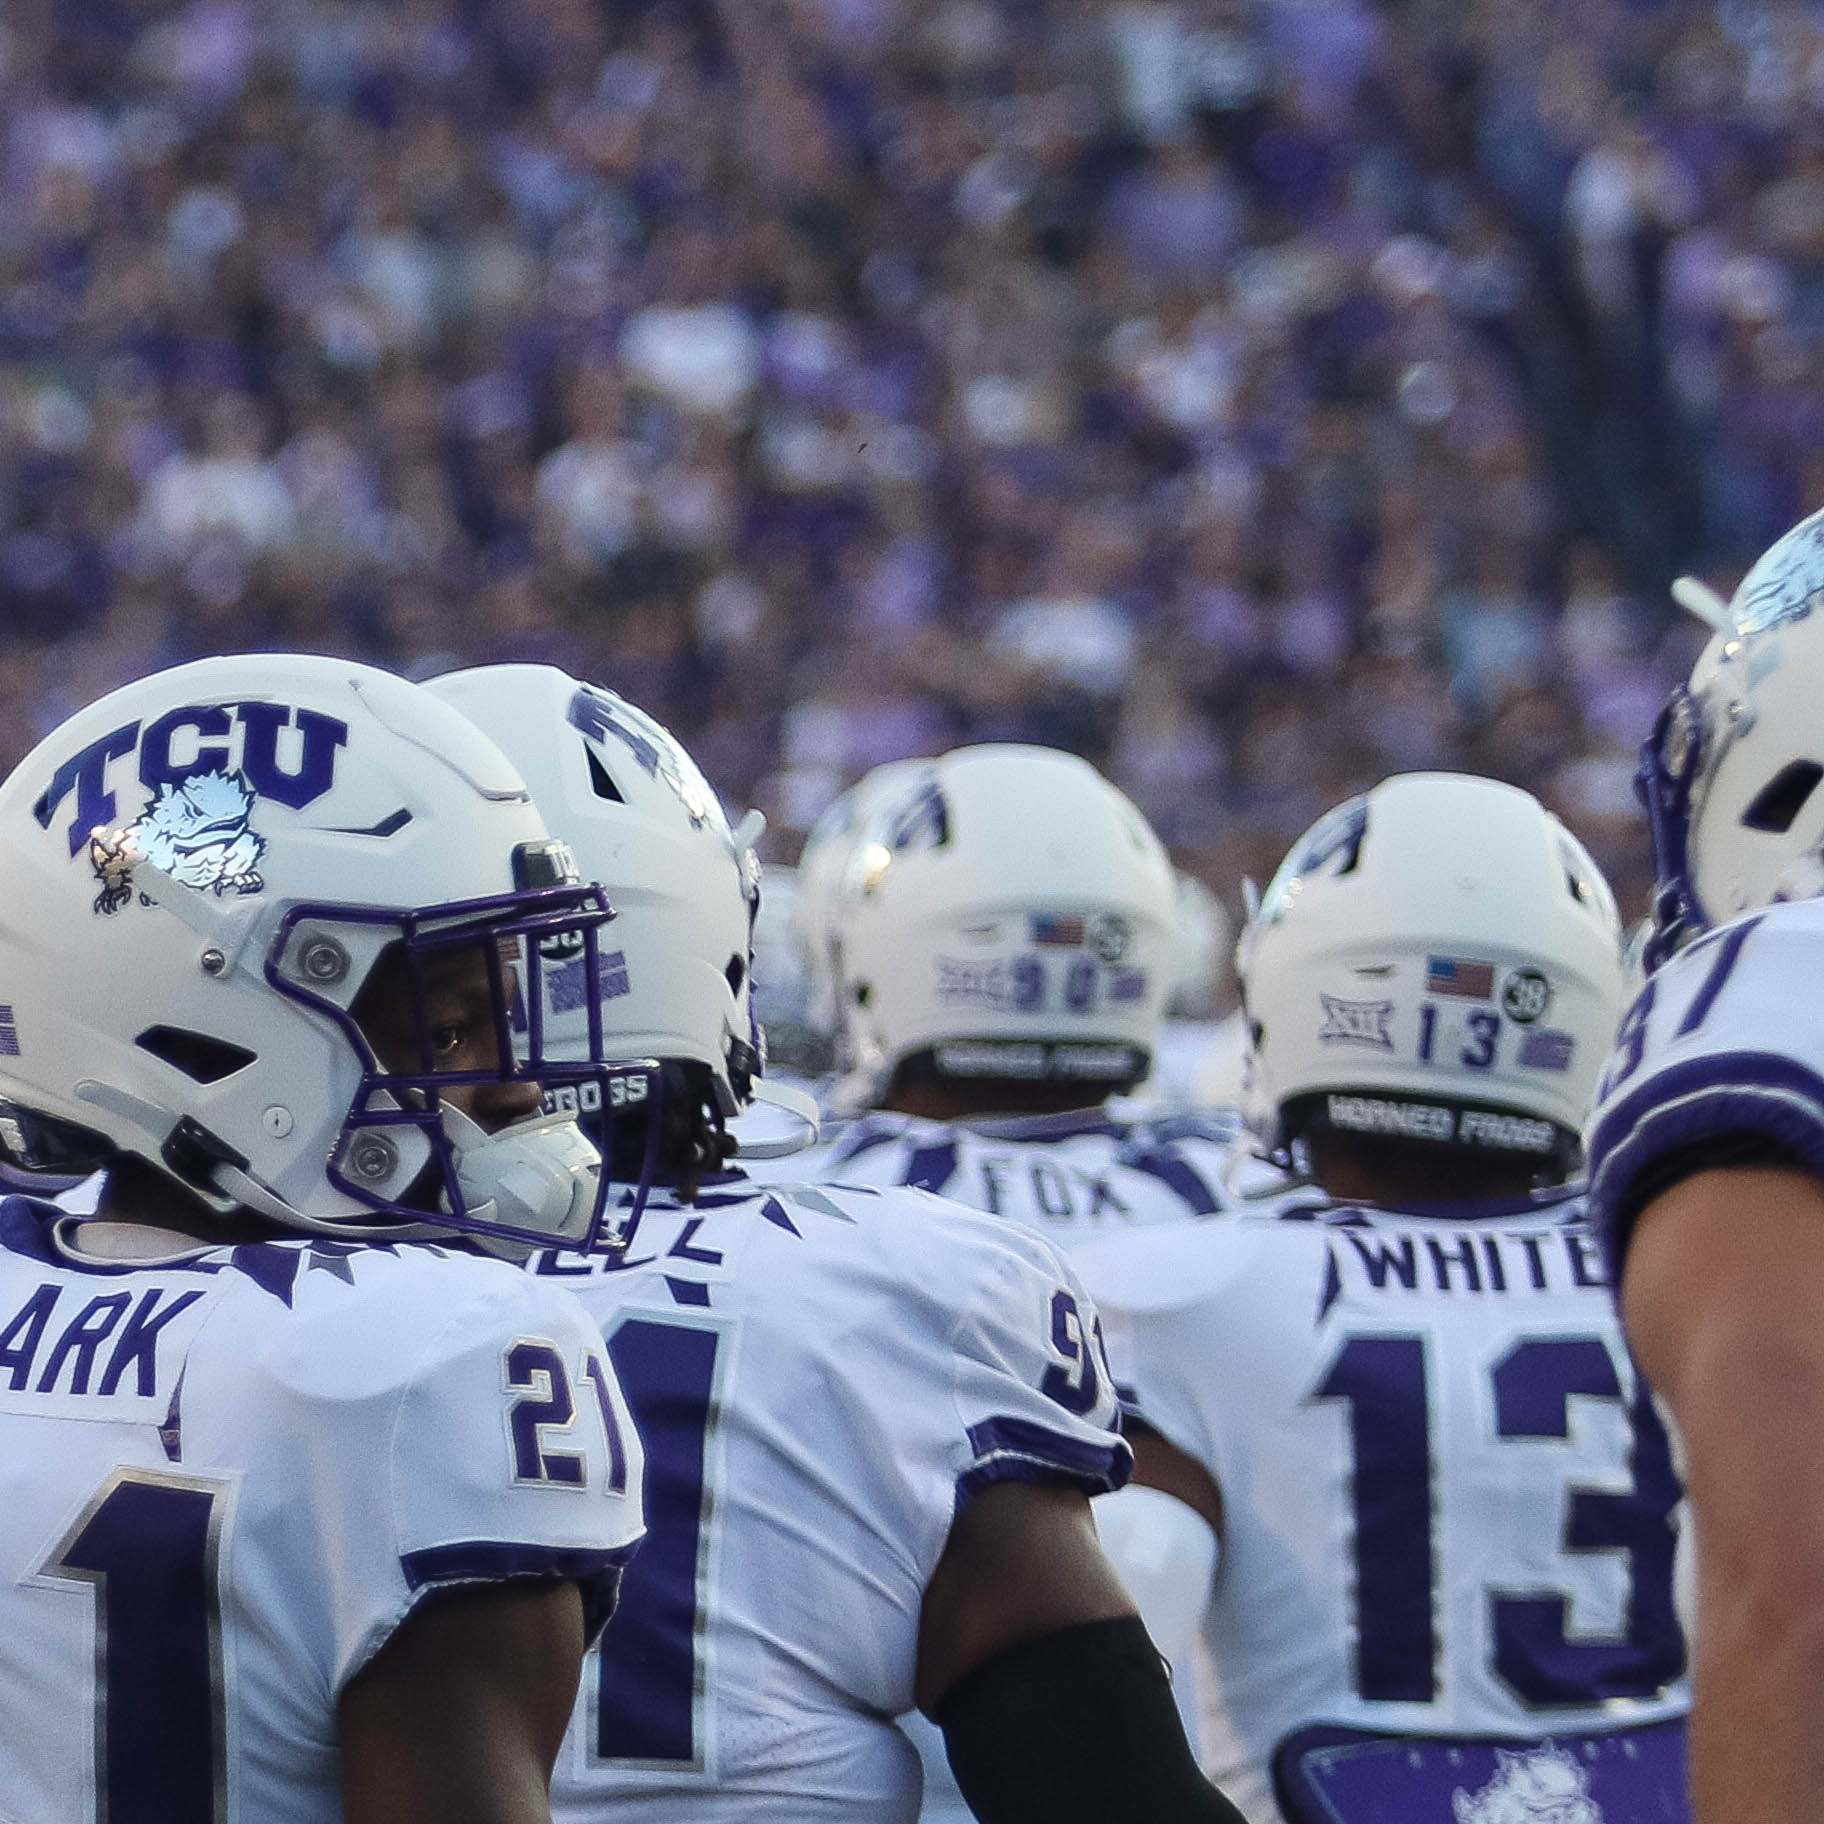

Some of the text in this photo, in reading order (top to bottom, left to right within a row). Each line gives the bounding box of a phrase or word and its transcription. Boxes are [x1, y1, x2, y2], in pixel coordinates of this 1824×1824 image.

[32, 701, 348, 858] TCU
[1416, 1003, 1499, 1068] 13
[1344, 1229, 1614, 1292] WHITE
[504, 1340, 627, 1492] 21
[1312, 1330, 1697, 1708] 13
